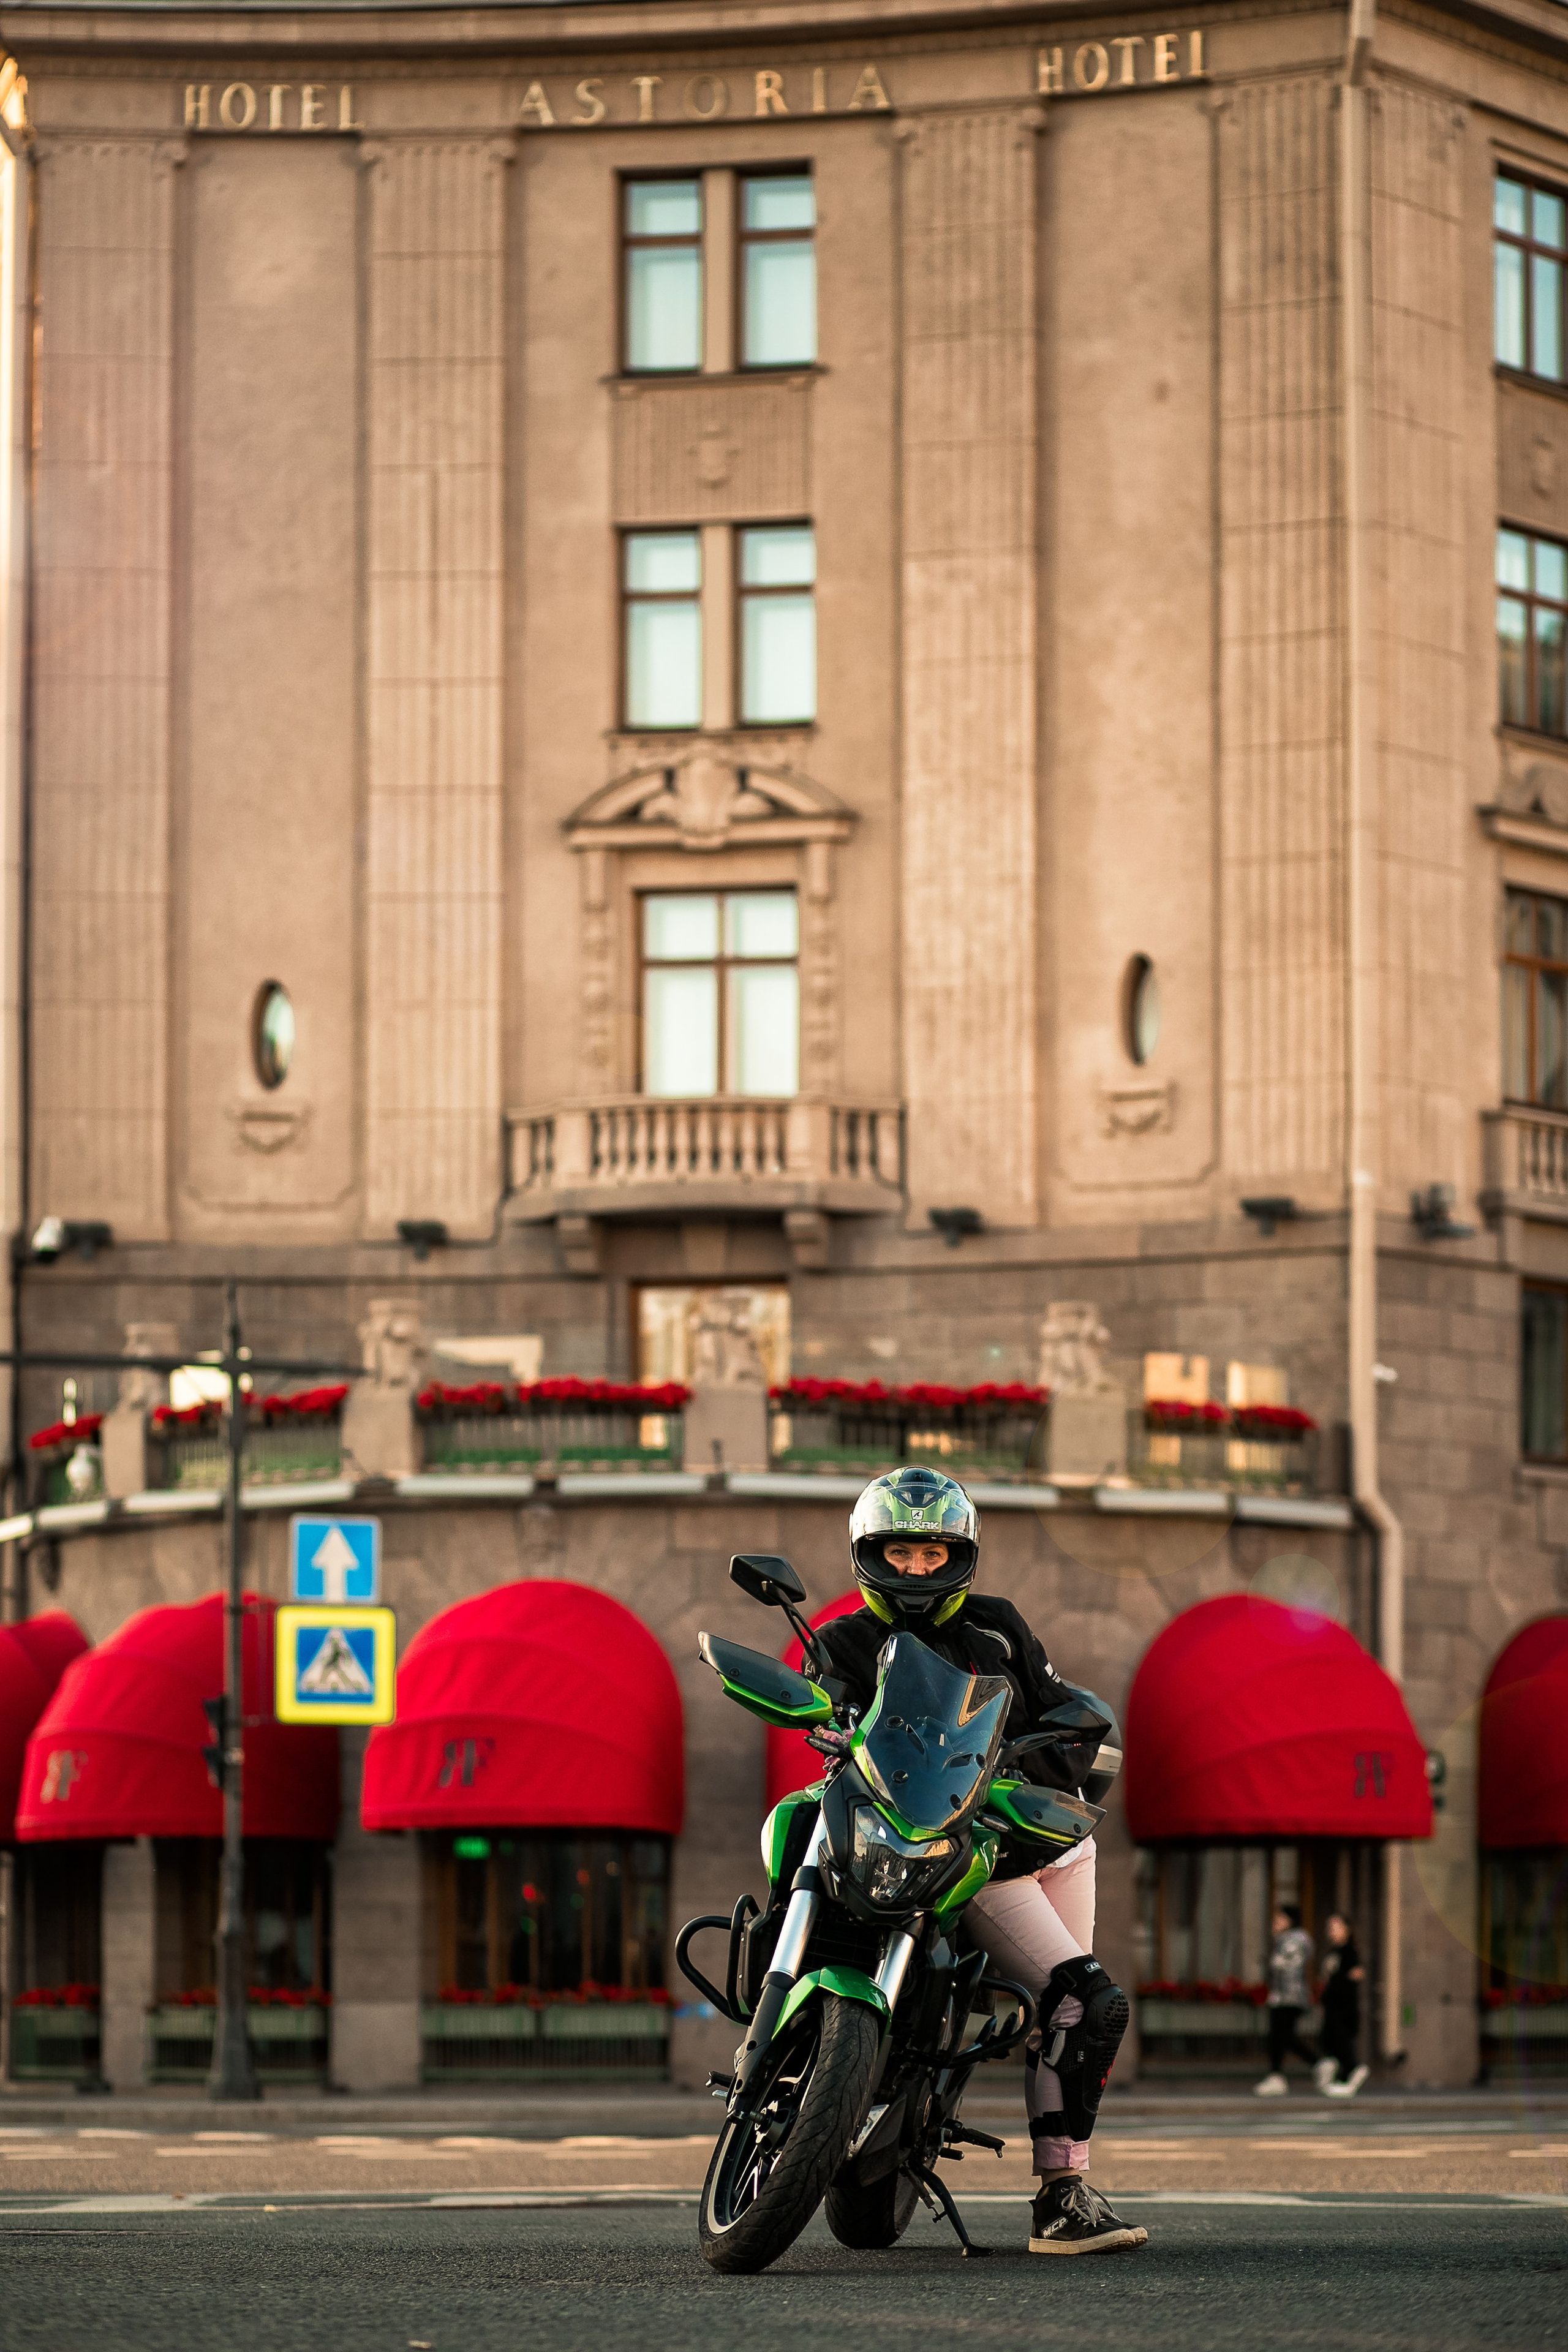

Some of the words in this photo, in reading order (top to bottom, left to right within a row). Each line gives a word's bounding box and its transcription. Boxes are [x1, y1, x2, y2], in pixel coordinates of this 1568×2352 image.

[184, 82, 365, 131] HOTEL
[520, 64, 891, 125] ASTORIA
[1038, 30, 1210, 94] HOTEL
[894, 1520, 940, 1529] SHARK
